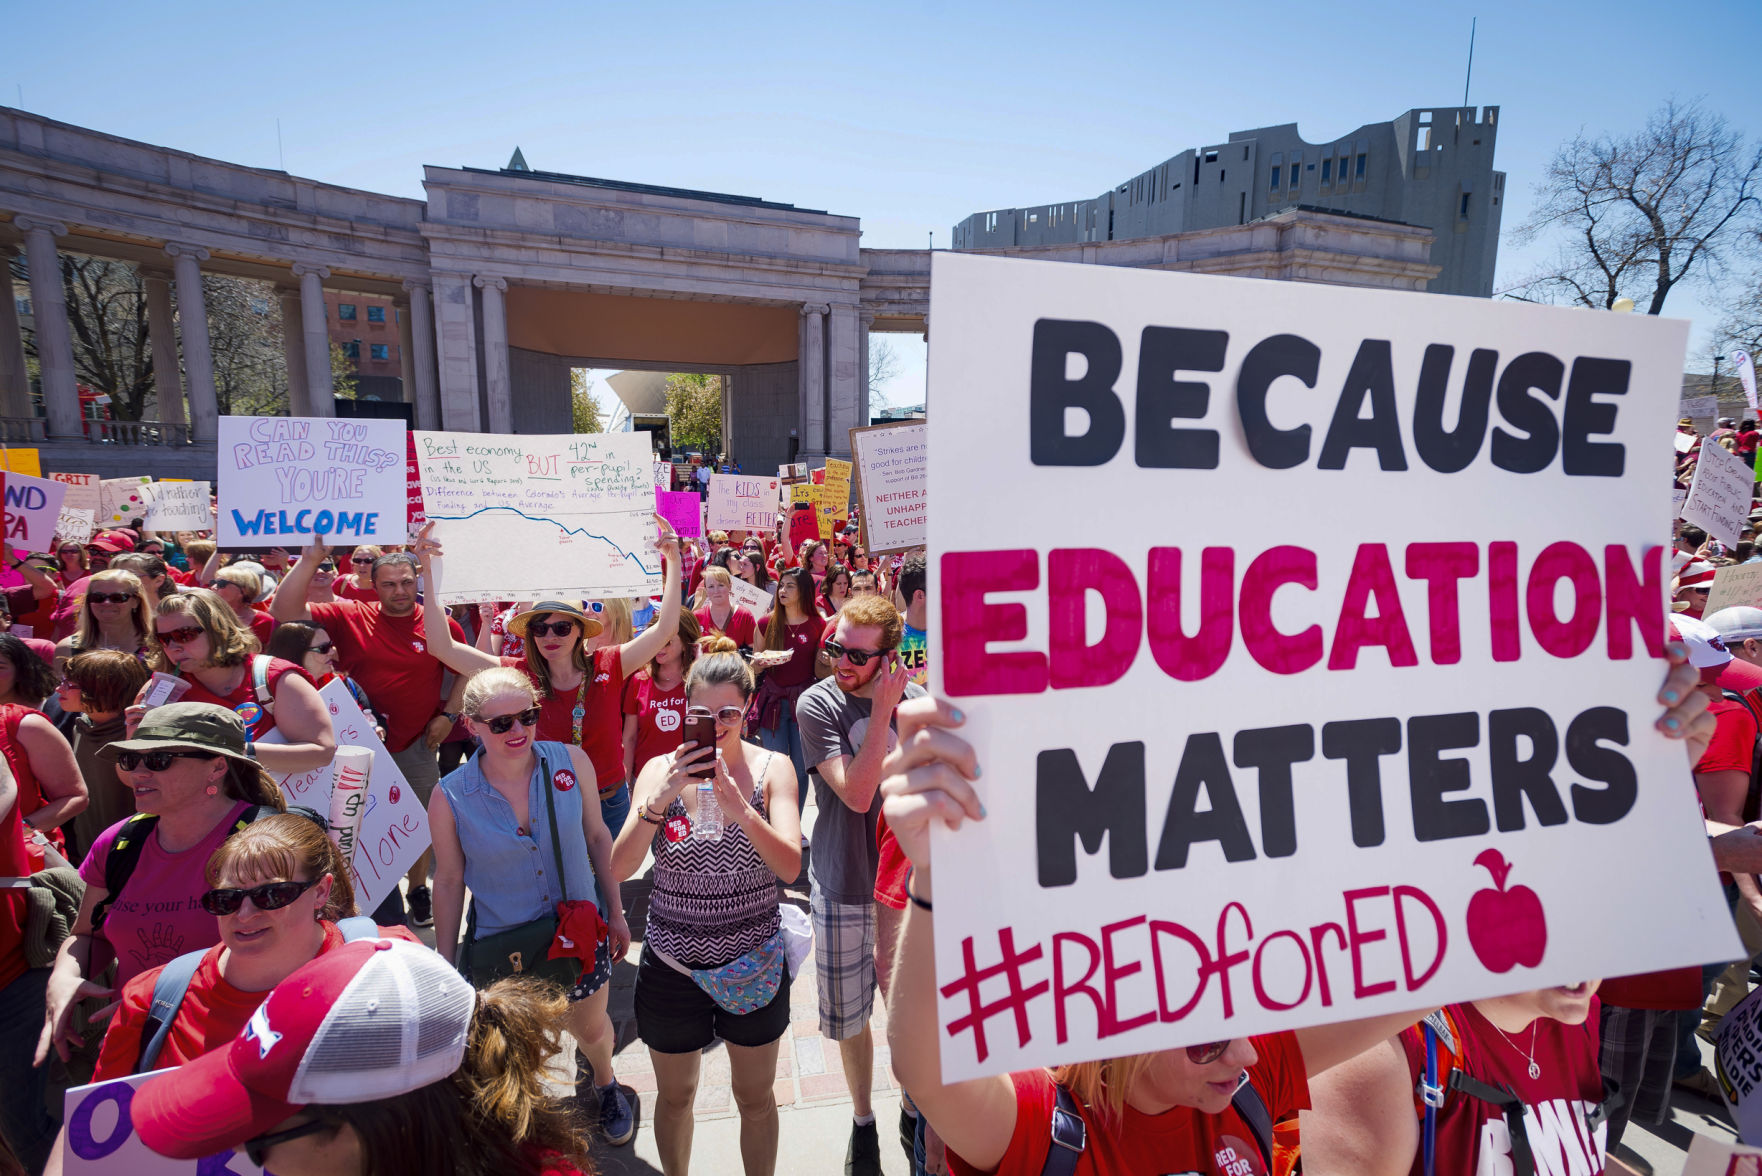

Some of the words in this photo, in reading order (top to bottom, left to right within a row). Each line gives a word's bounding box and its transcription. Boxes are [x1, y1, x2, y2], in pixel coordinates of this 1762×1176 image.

[1030, 317, 1633, 478] BECAUSE
[250, 418, 310, 443] CAN
[326, 421, 368, 442] YOU
[233, 441, 315, 470] READ
[324, 440, 400, 473] THIS?
[423, 437, 458, 456] Best
[466, 446, 524, 464] economy
[605, 451, 615, 459] in
[424, 464, 434, 473] in
[443, 461, 462, 474] the
[473, 460, 492, 475] US
[526, 454, 561, 476] BUT
[570, 459, 631, 478] per-pupil
[871, 460, 890, 471] good
[891, 458, 903, 466] for
[55, 473, 92, 486] GRIT
[275, 465, 367, 504] YOU'RE
[716, 479, 730, 495] The
[735, 481, 761, 496] KIDS
[166, 486, 202, 501] rather
[425, 486, 474, 496] Difference
[482, 489, 517, 498] between
[525, 488, 566, 498] Colorado's
[572, 488, 601, 503] Average
[876, 489, 919, 504] NEITHER
[162, 503, 208, 524] teaching
[437, 500, 466, 513] Funding
[518, 499, 554, 512] Average
[727, 499, 738, 514] my
[742, 497, 764, 508] class
[886, 503, 928, 516] UNHAPP
[1689, 493, 1713, 517] START
[1732, 504, 1746, 515] AND
[230, 508, 380, 537] WELCOME
[745, 511, 778, 529] BETTER
[939, 540, 1666, 698] EDUCATION
[650, 698, 668, 709] Red
[670, 697, 684, 706] for
[661, 715, 676, 727] ED
[554, 772, 566, 781] RED
[560, 775, 572, 784] FOR
[566, 779, 574, 787] ED
[1036, 706, 1639, 889] MATTERS
[668, 820, 682, 829] RED
[141, 901, 184, 917] your
[939, 883, 1448, 1064] #REDforED
[1729, 1064, 1754, 1098] DIE
[1215, 1146, 1237, 1168] RED
[1225, 1158, 1253, 1176] FOR
